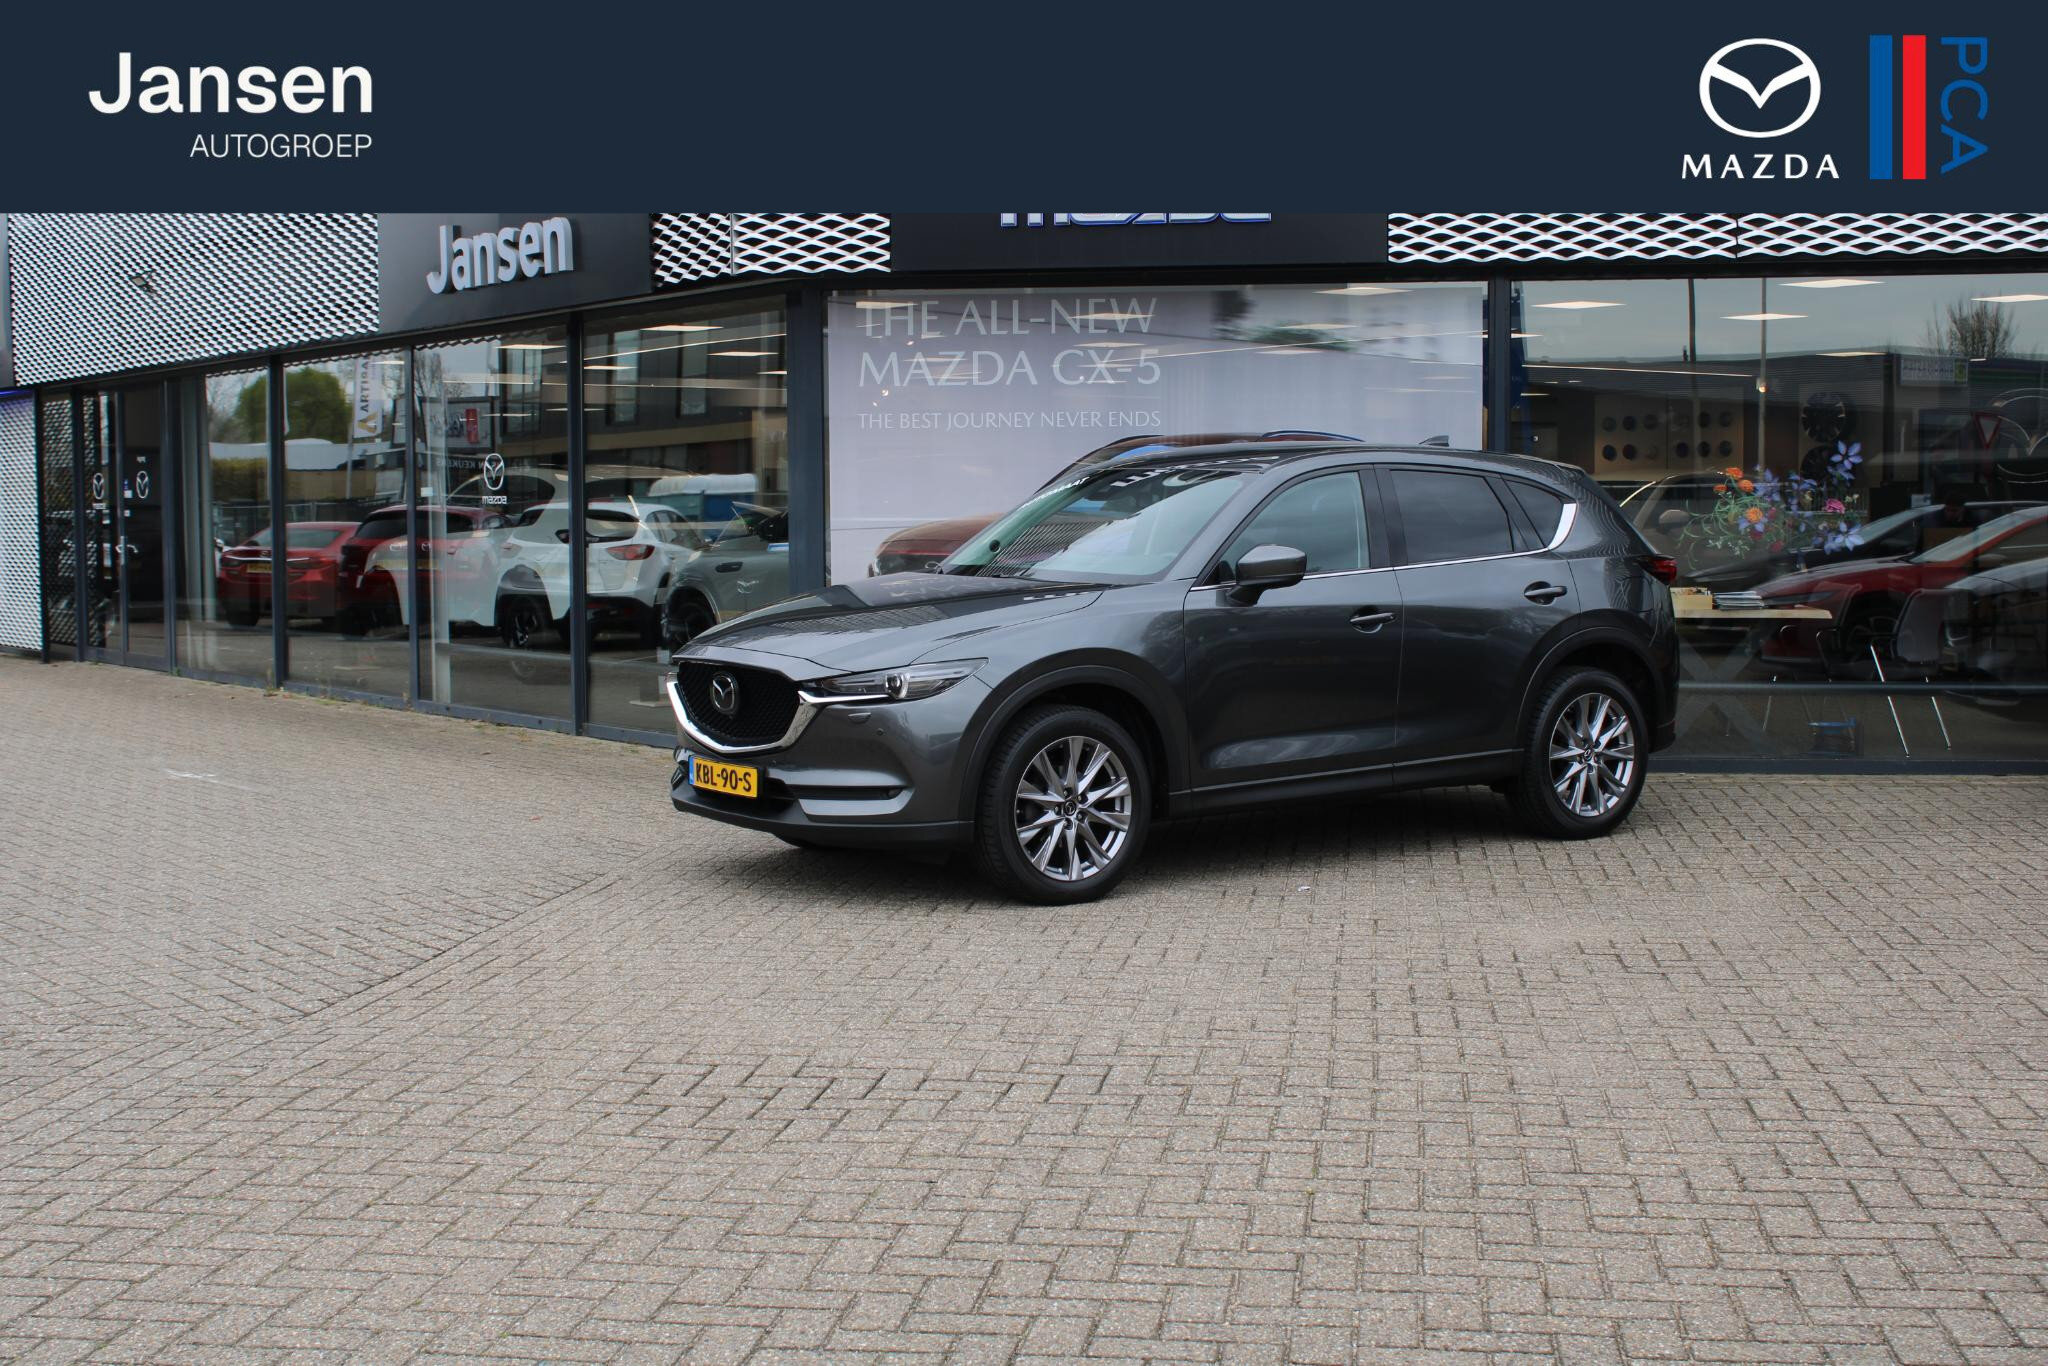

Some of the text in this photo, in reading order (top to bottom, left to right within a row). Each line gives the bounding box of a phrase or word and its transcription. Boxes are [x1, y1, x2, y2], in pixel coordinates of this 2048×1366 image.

[426, 216, 574, 294] Jansen
[857, 297, 1158, 339] THE ALL-NEW
[858, 348, 1161, 387] MAZDA CX-5
[856, 410, 1161, 432] THE BEST JOURNEY NEVER ENDS
[481, 495, 507, 505] mazda
[695, 762, 752, 793] KBL-90-S
